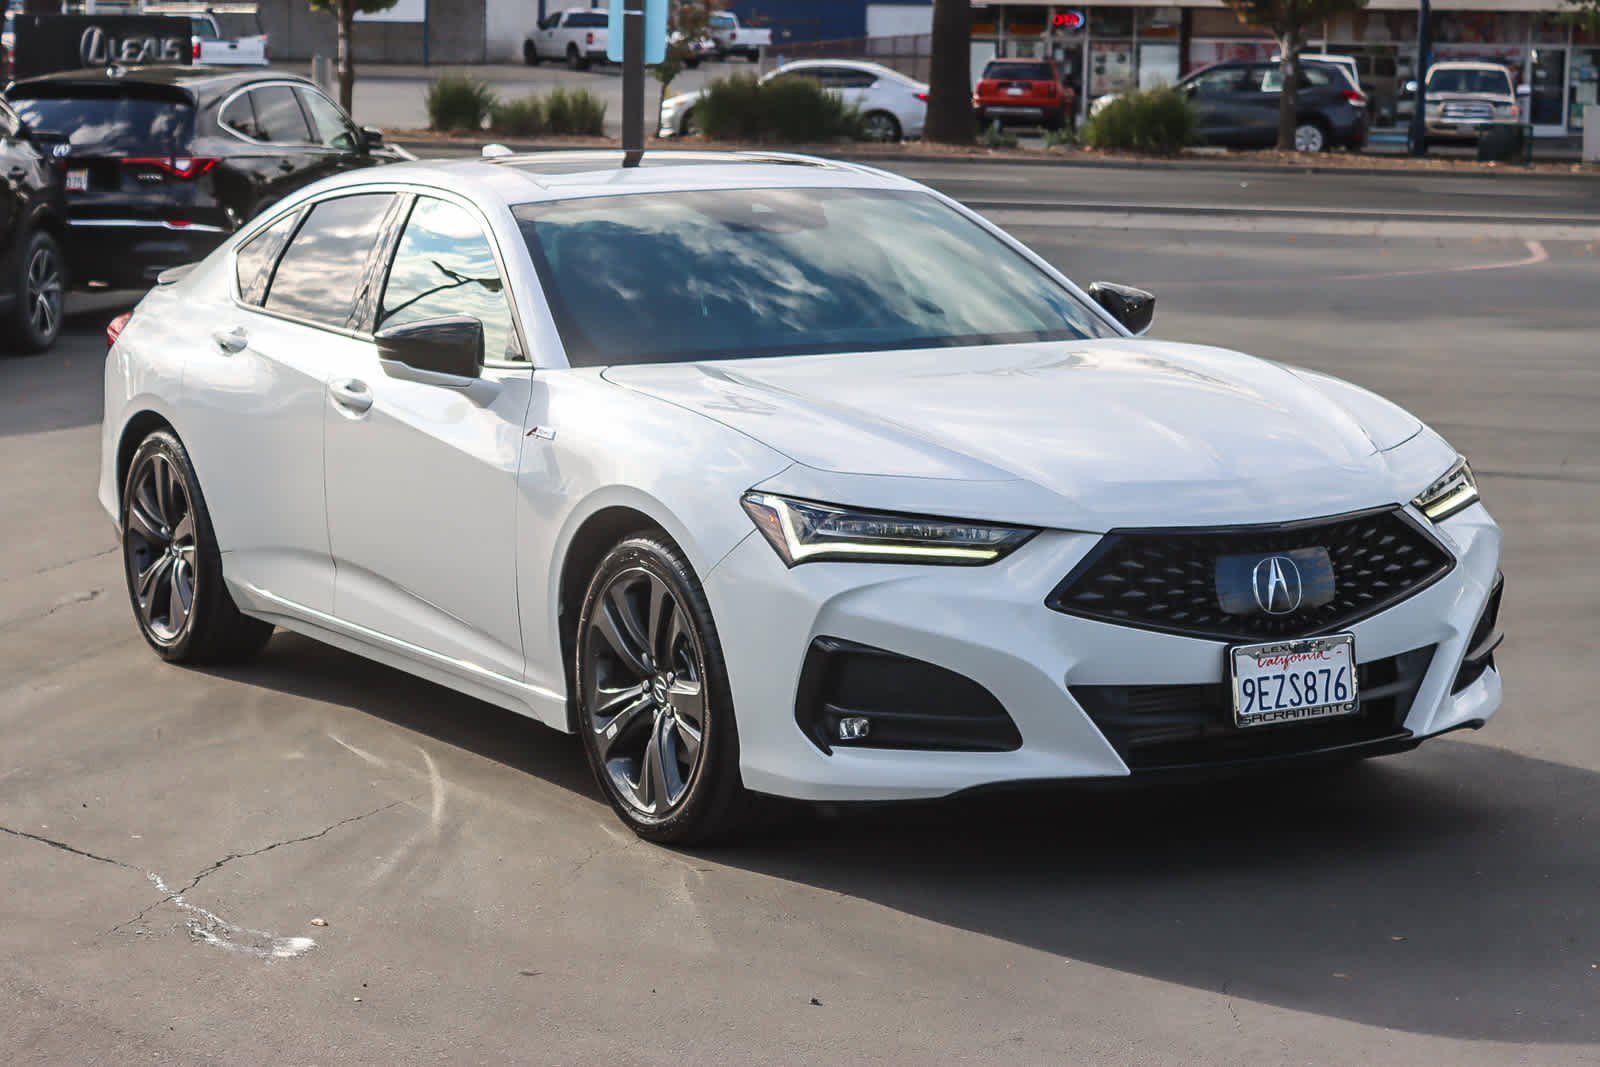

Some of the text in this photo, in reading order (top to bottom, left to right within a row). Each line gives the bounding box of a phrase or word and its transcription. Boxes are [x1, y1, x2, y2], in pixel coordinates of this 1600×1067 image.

[1258, 651, 1331, 671] California
[1242, 666, 1347, 713] 9EZS876
[1240, 702, 1355, 726] SACRAMENTO
